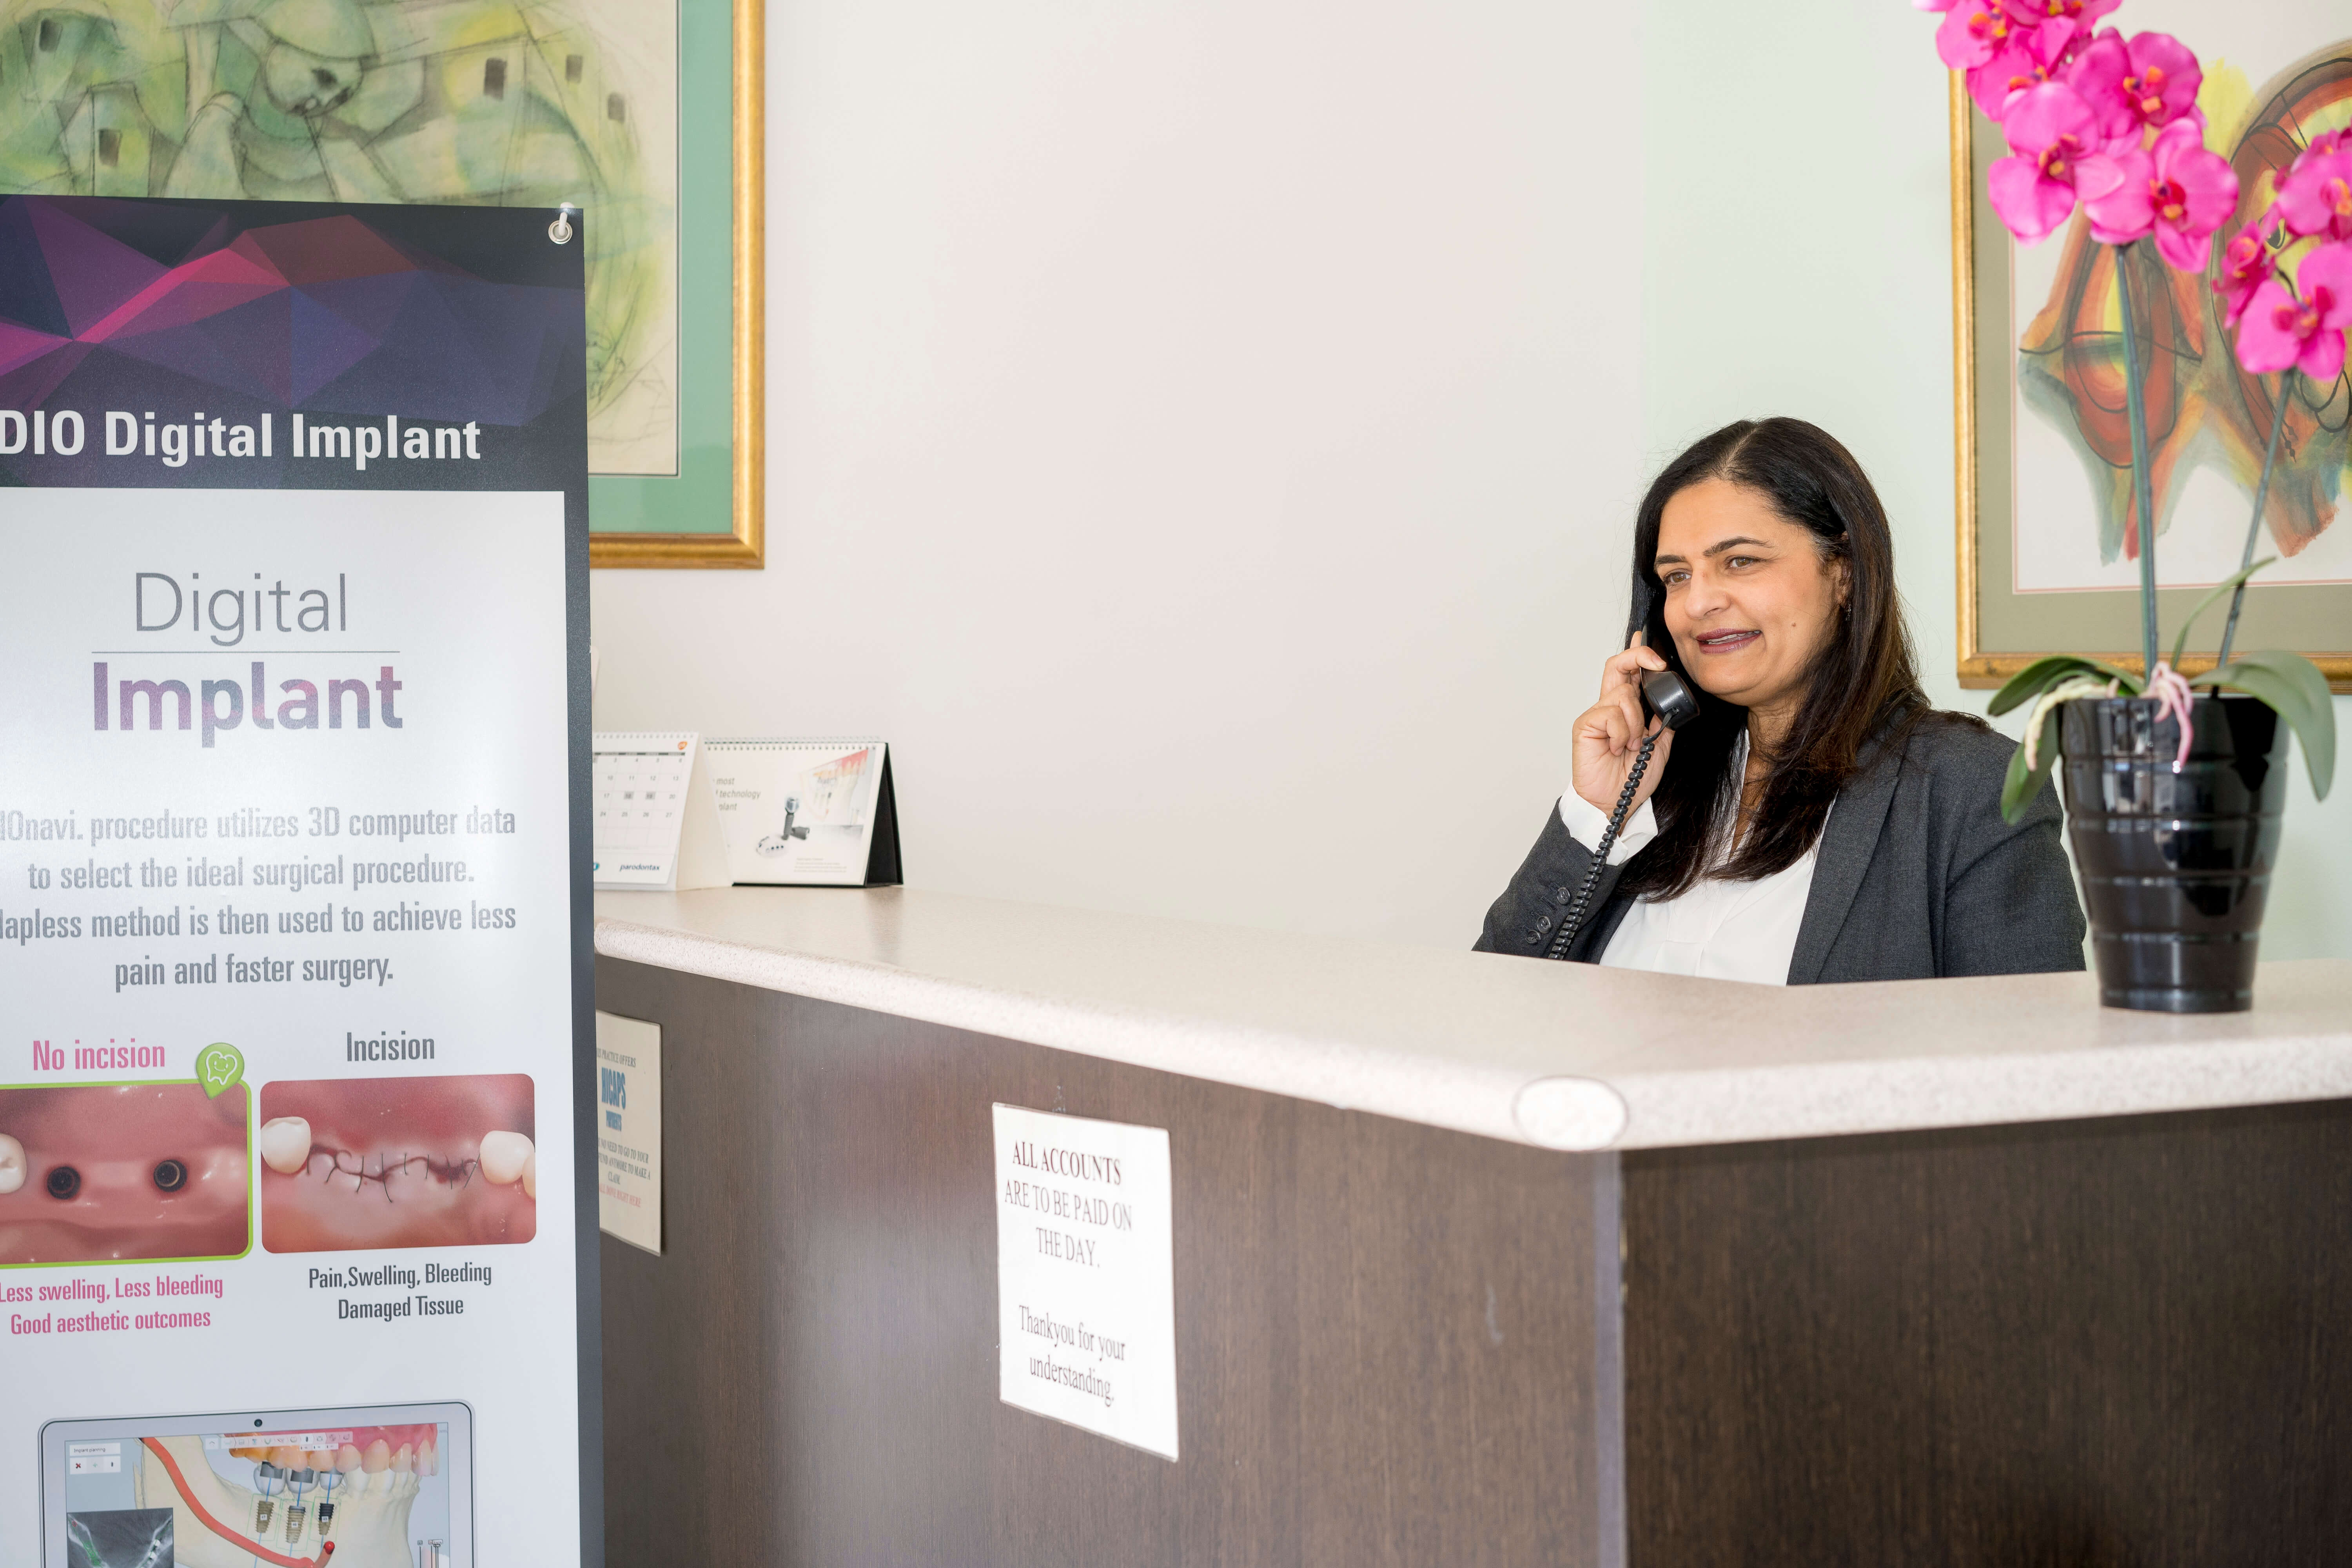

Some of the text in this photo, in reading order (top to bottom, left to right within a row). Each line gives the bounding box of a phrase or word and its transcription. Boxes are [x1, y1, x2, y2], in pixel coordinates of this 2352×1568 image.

[0, 410, 481, 471] DIO Digital Implant
[135, 572, 347, 647] Digital
[93, 661, 403, 748] Implant
[720, 789, 761, 800] technology
[91, 809, 207, 847] procedure
[217, 808, 299, 838] utilizes
[309, 806, 339, 837] 3D
[349, 809, 458, 842] computer
[466, 805, 515, 835] data
[28, 853, 474, 892] to select the ideal surgical procedure.
[620, 863, 661, 871] parodontax
[92, 906, 180, 937] method
[190, 905, 209, 935] is
[218, 904, 269, 935] then
[279, 903, 332, 933] used
[342, 906, 363, 932] to
[373, 901, 462, 931] achieve
[471, 900, 516, 929] less
[116, 953, 393, 993] pain and faster surgery.
[33, 1039, 166, 1071] No incision
[347, 1031, 435, 1062] Incision
[602, 1049, 619, 1063] PRACTICE
[619, 1054, 636, 1068] OFFERS
[601, 1066, 626, 1110] HICAPS
[618, 1144, 623, 1155] TO
[624, 1147, 630, 1158] GO
[630, 1149, 637, 1160] TO
[637, 1151, 649, 1163] YOUR
[1012, 1140, 1122, 1186] ALL ACCOUNTS
[628, 1163, 634, 1174] TO
[635, 1165, 647, 1179] MAKE
[1004, 1179, 1133, 1231] ARE TO BE PAID ON
[1036, 1227, 1062, 1258] THE
[0, 1274, 223, 1303] Less swelling, Less bleeding
[424, 1261, 492, 1286] Bleeding
[11, 1310, 211, 1335] Good aesthetic outcomes
[338, 1295, 464, 1321] Damaged Tissue
[1019, 1305, 1126, 1362] Thankyou for your
[1029, 1355, 1115, 1407] understanding.
